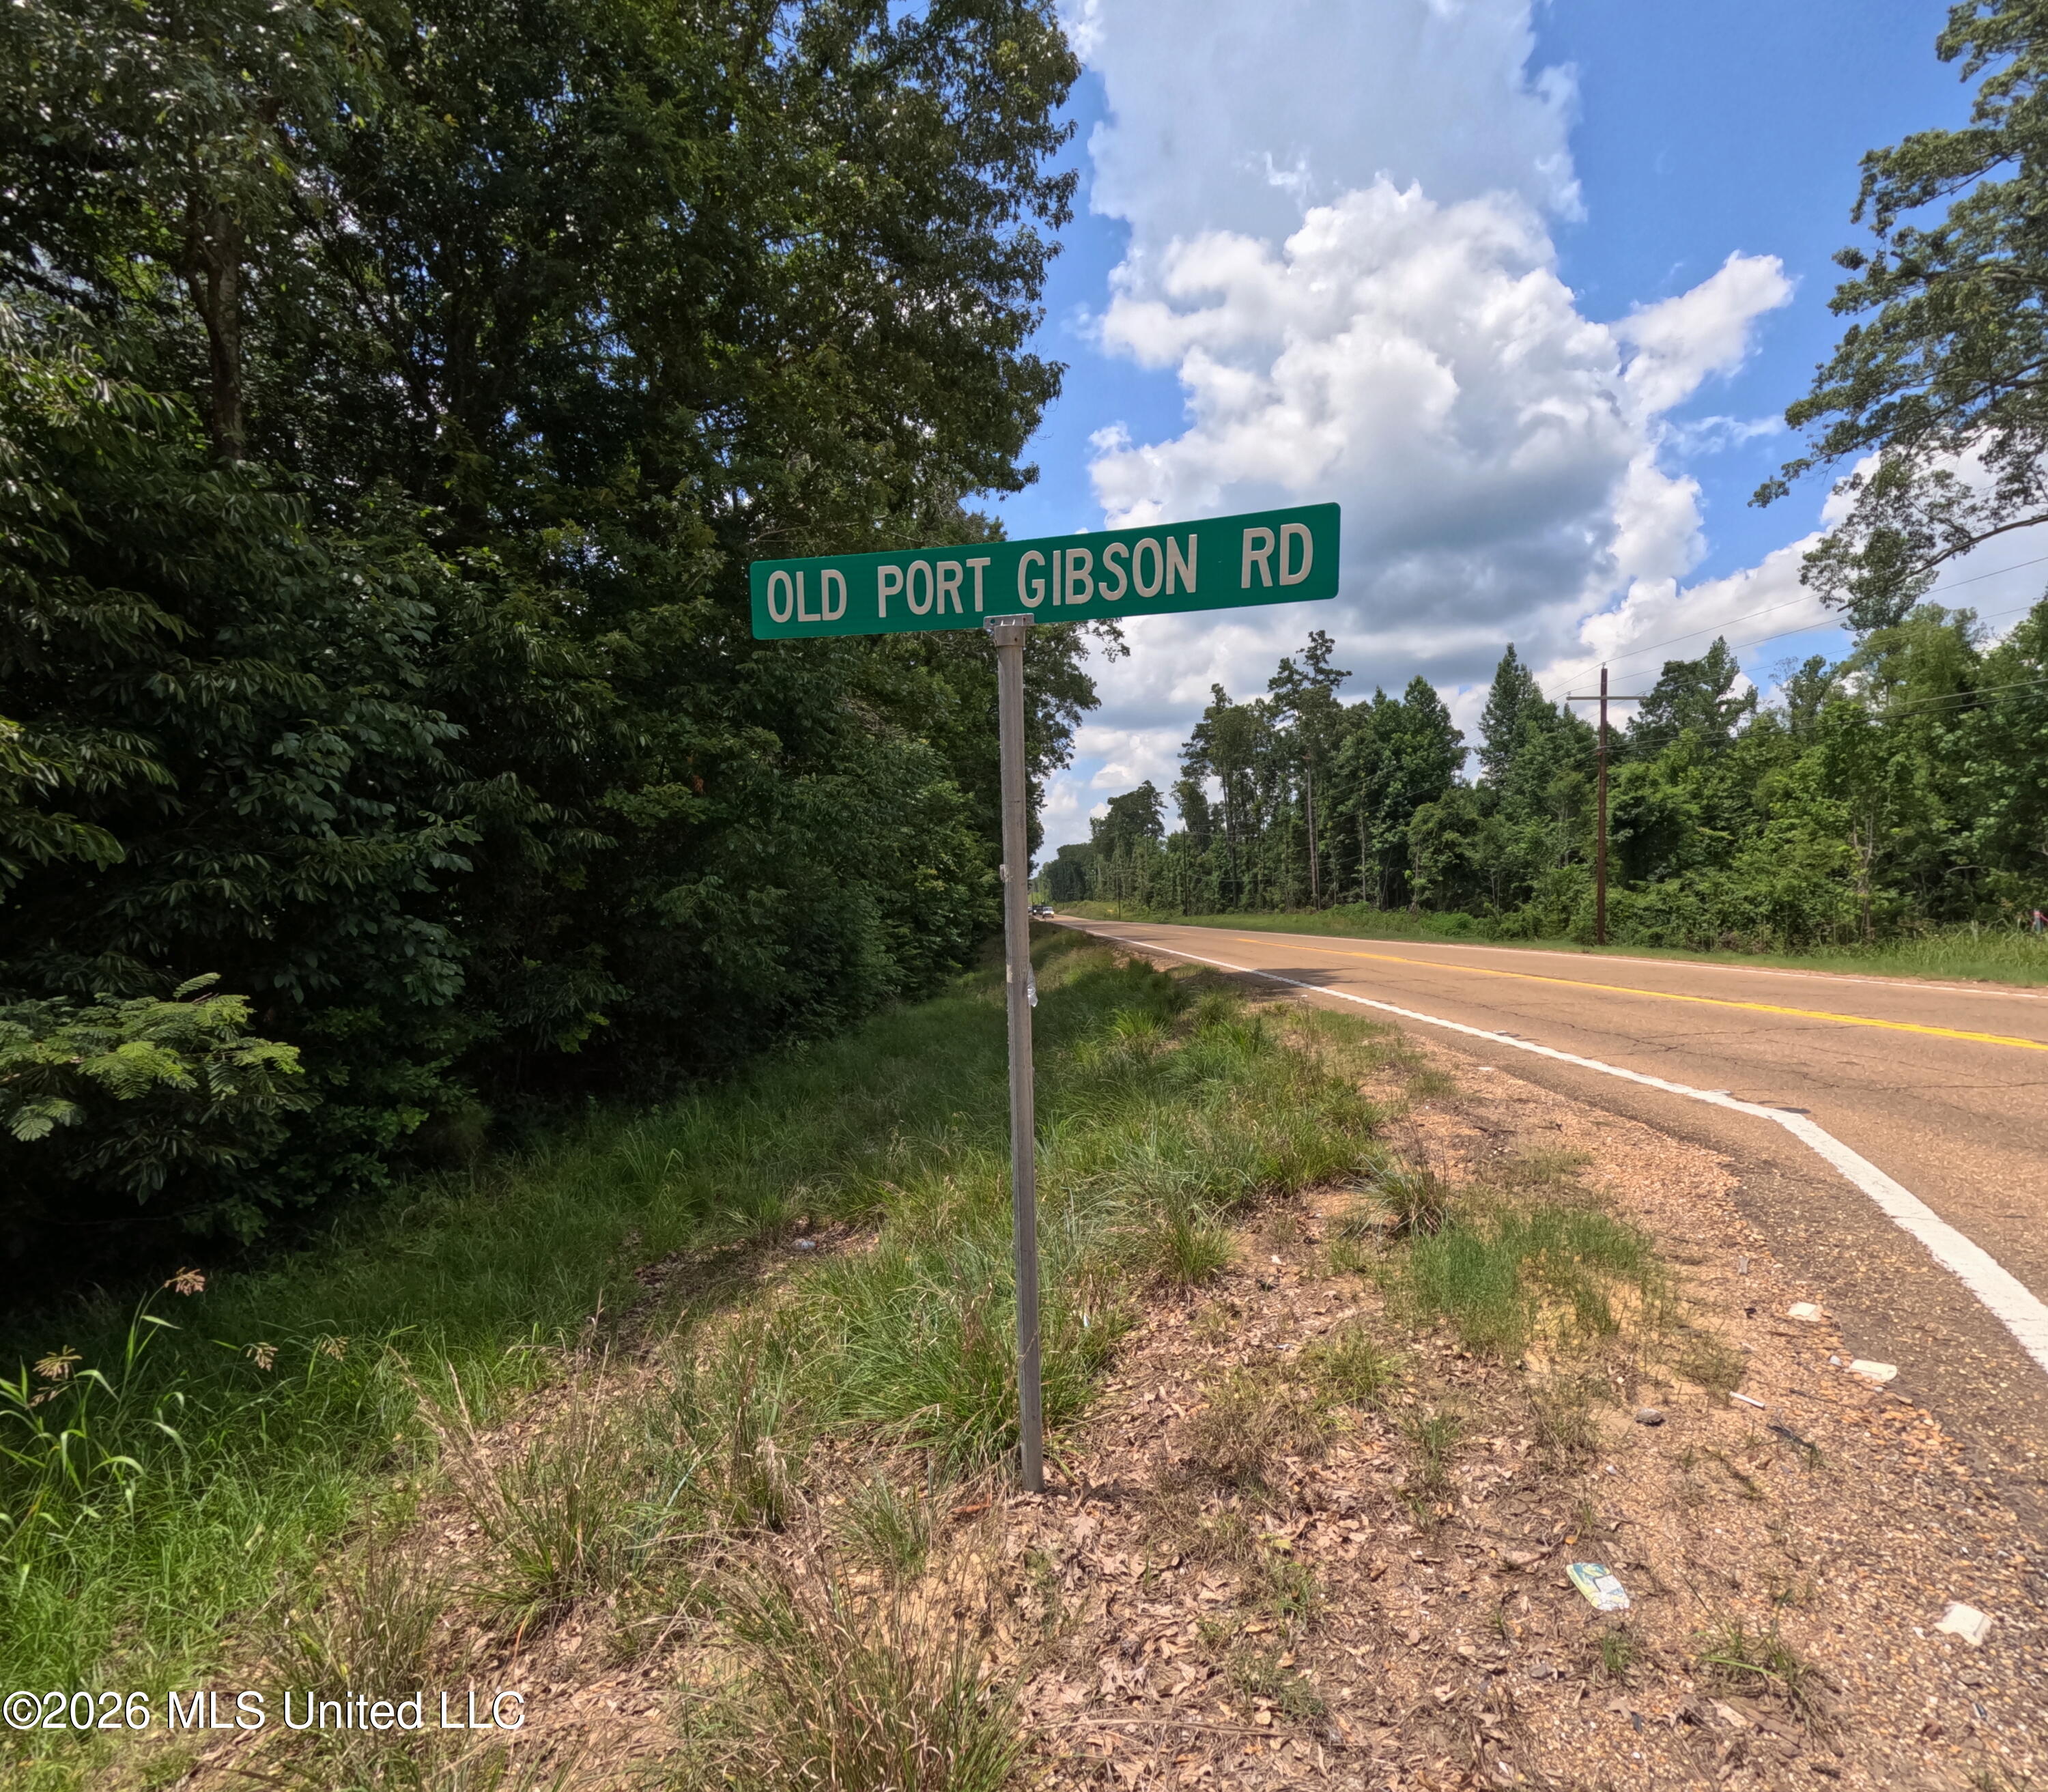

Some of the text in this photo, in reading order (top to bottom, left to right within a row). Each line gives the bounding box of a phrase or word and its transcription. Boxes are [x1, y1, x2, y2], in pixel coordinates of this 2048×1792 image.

[768, 524, 1313, 623] OLD PORT GIBSON RD
